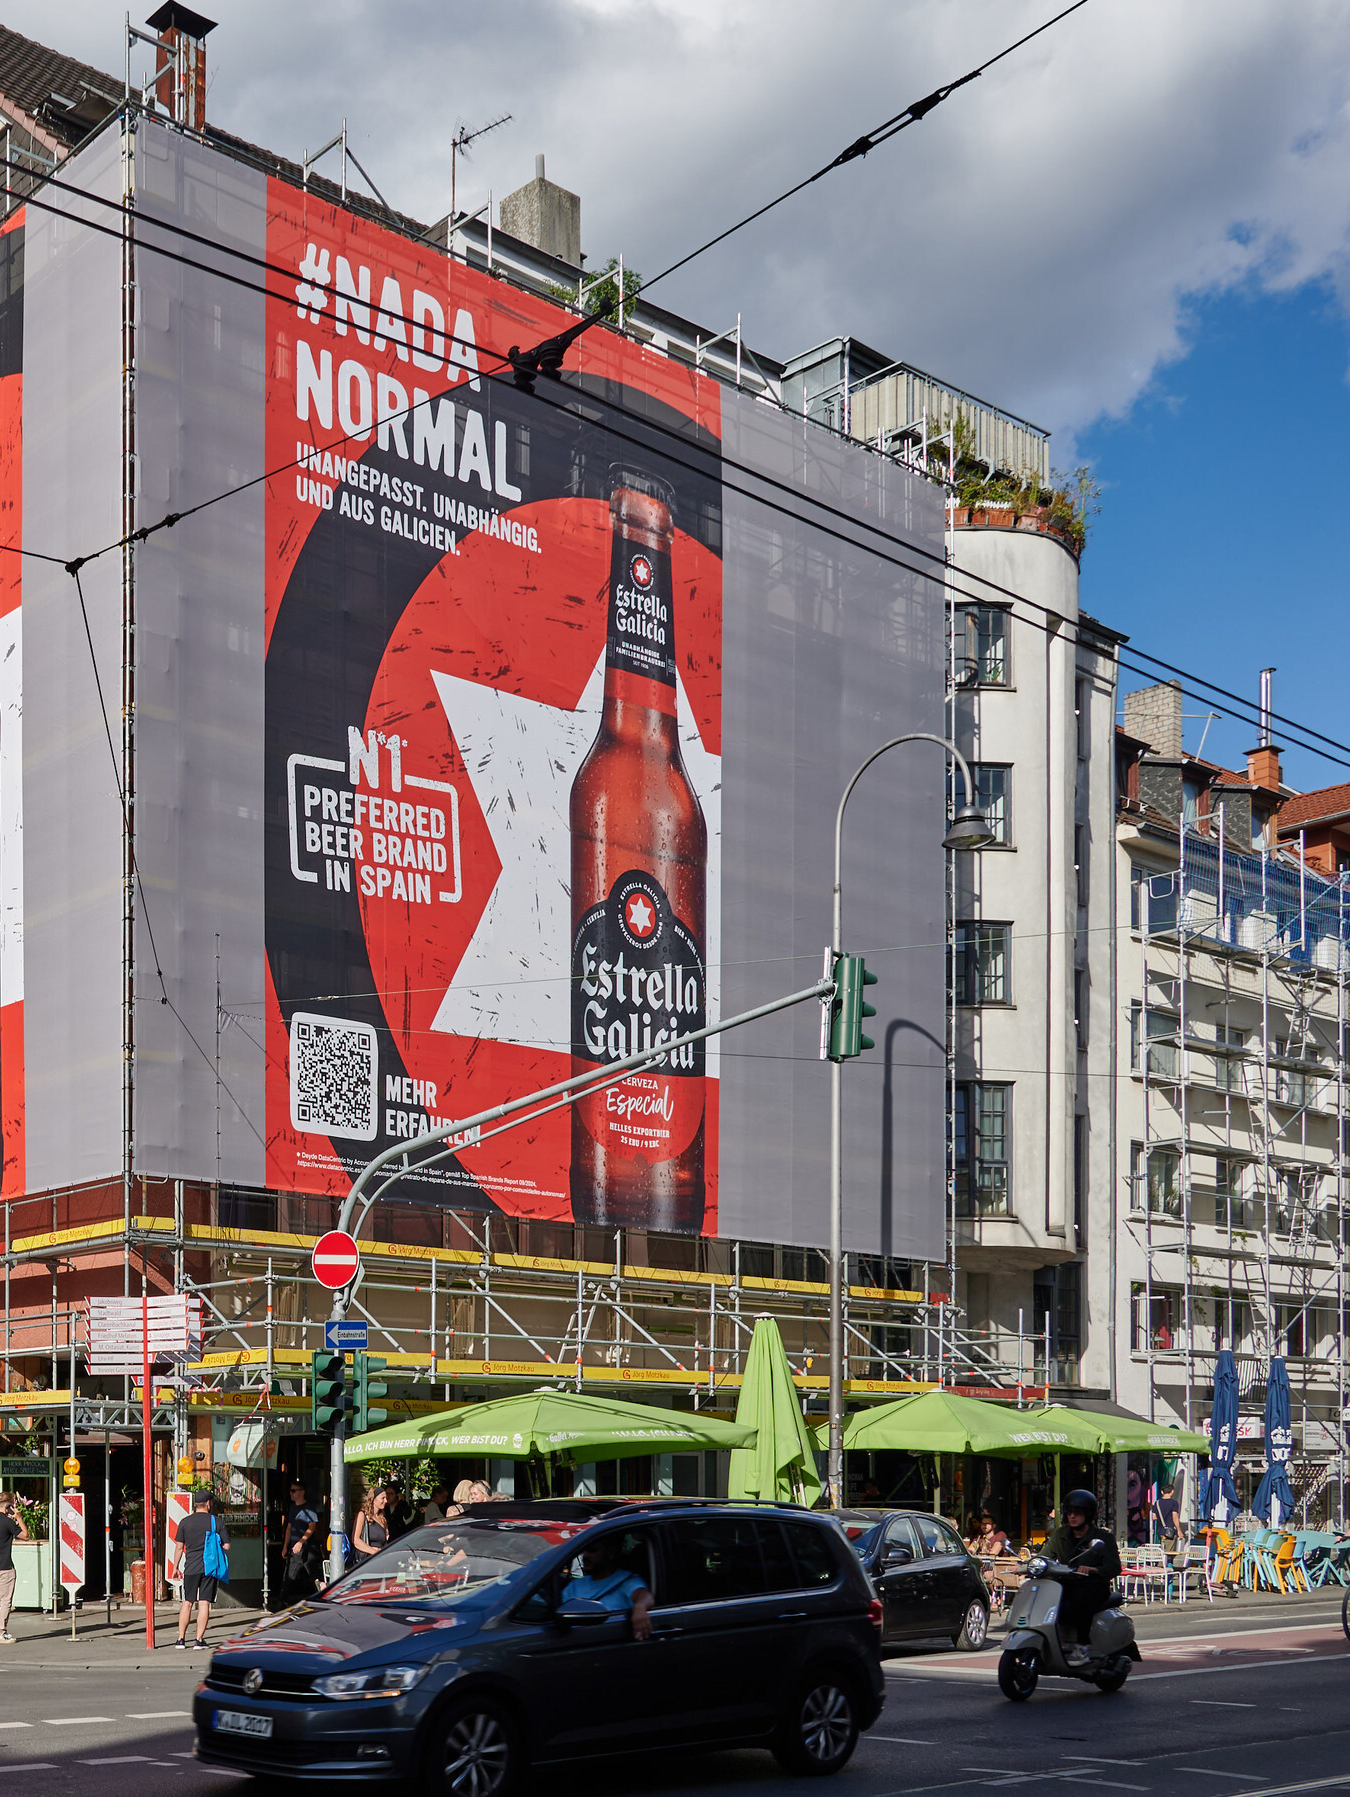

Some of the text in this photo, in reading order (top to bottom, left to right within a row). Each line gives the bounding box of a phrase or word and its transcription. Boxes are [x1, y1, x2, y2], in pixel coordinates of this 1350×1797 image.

[295, 243, 481, 392] #NADA
[296, 340, 522, 502] NORMAL
[296, 441, 542, 553] UNANGEPASST. UNABHÄNGIG.
[296, 475, 460, 556] UND AUS GALICIEN.
[615, 584, 668, 622] Estrella
[615, 607, 666, 645] Galicia
[303, 784, 446, 839] PREFERRED
[305, 821, 447, 873] BEER BRAND
[325, 859, 432, 905] IN SPAIN
[620, 882, 661, 909] ESTRELLA GALICIA
[618, 914, 643, 949] CERVECEROS
[643, 937, 658, 949] DESDE
[580, 942, 698, 1014] Estrella
[583, 1000, 695, 1069] Galicia
[385, 1074, 437, 1108] MEHR
[605, 1085, 674, 1121] Especial
[609, 1122, 670, 1138] HELLES EXPORTBIER
[620, 1136, 628, 1144] 25
[470, 1173, 487, 1181] Spanish
[58, 1229, 93, 1241] Jörg Motzkau
[204, 1353, 239, 1364] örg Motzka
[493, 1364, 535, 1373] Jörg Motzkau
[632, 1370, 670, 1380] Jörg Motzkau
[4, 1393, 38, 1403] Jörg Motzkau
[344, 1443, 363, 1455] ALLO,
[364, 1441, 379, 1450] ICH
[379, 1440, 394, 1449] BIN
[394, 1438, 416, 1448] HERR
[451, 1435, 471, 1444] WER
[470, 1435, 491, 1444] BIST
[491, 1435, 508, 1445] DU?
[1009, 1431, 1068, 1443] WER BIST DU?
